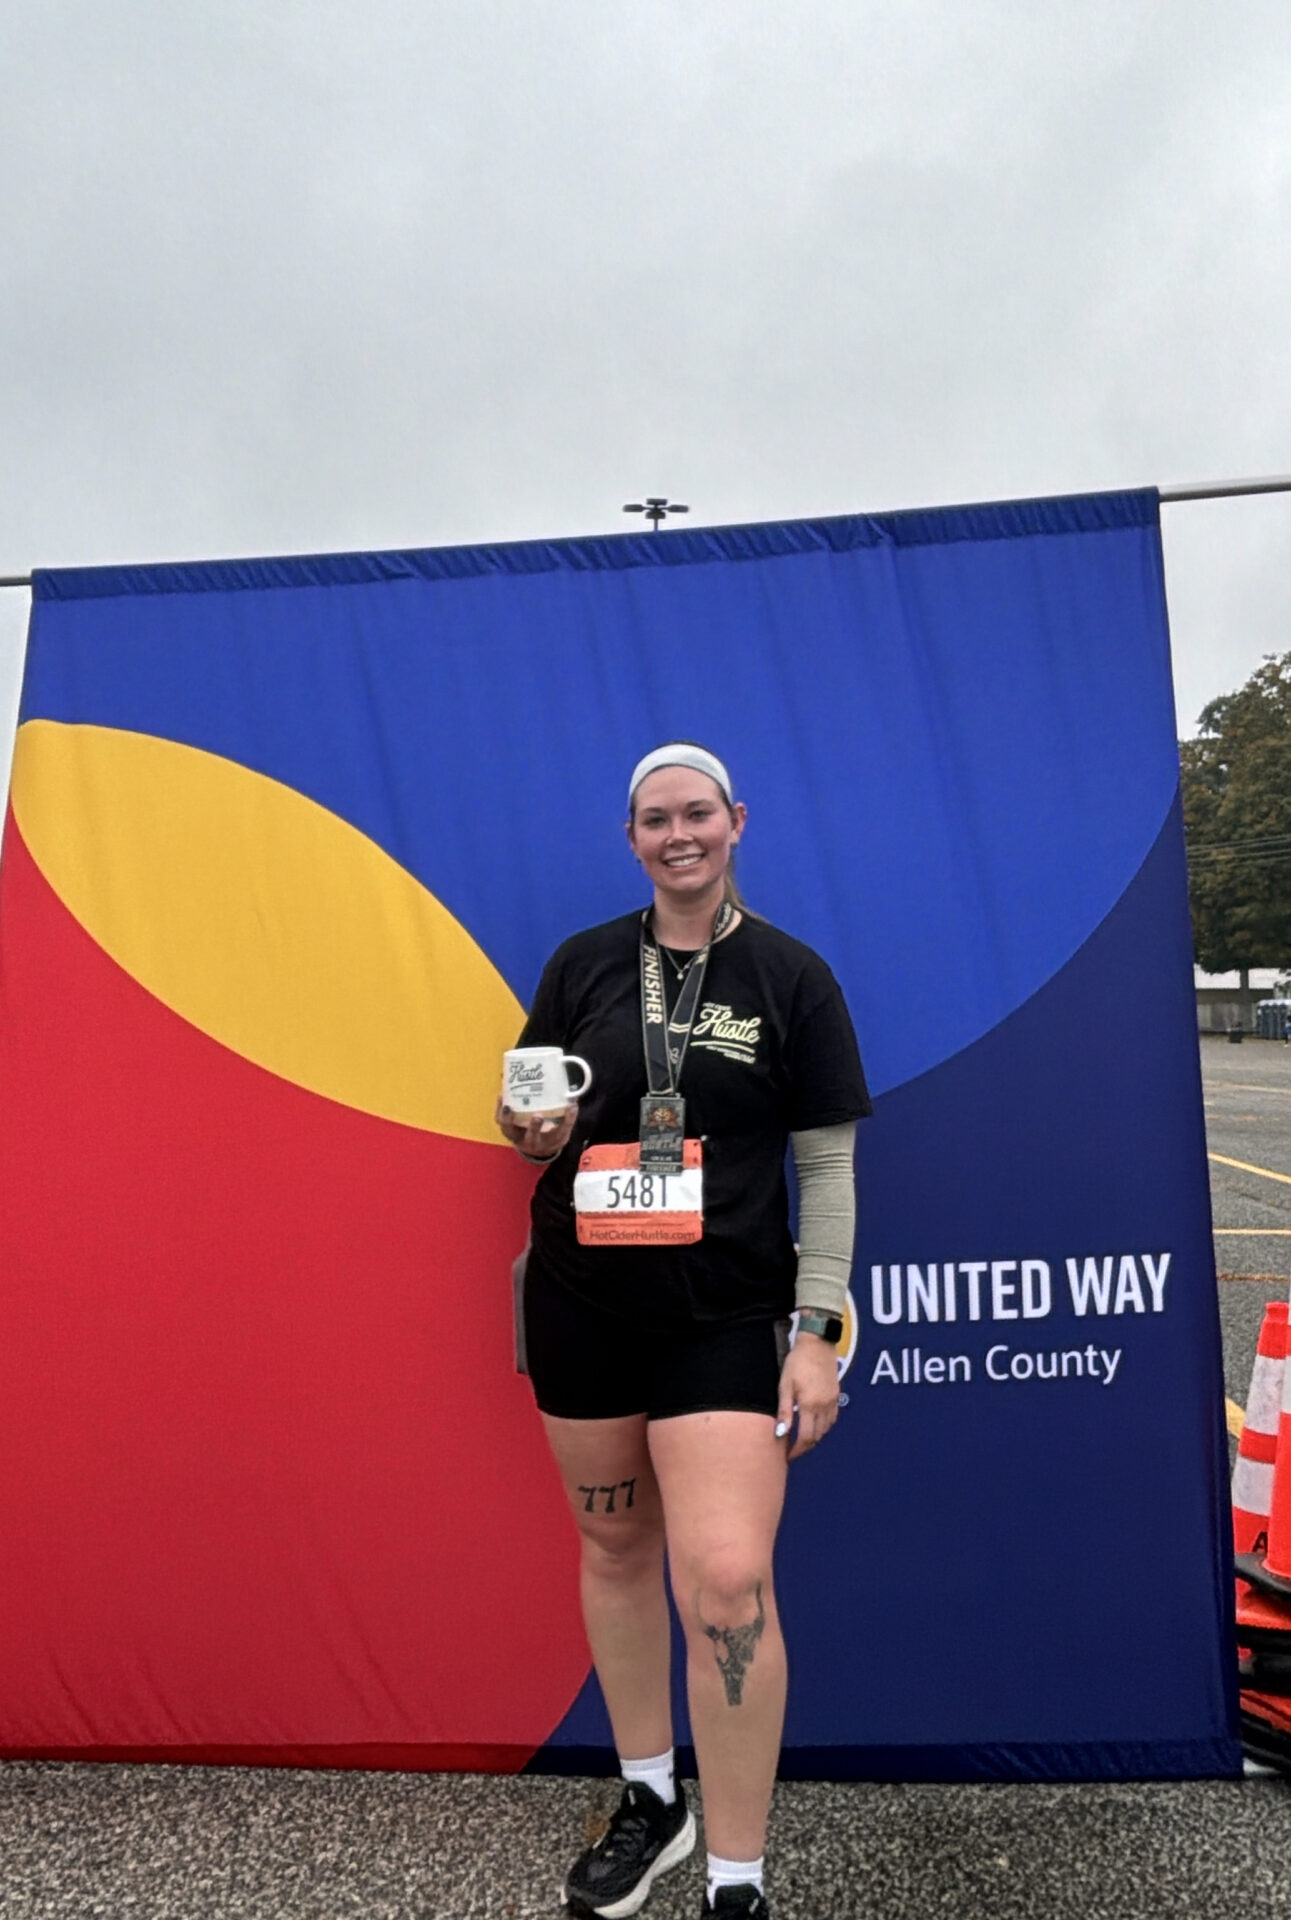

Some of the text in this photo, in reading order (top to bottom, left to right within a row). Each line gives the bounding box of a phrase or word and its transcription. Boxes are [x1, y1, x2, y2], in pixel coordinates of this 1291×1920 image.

[643, 944, 663, 1024] FINISHER
[692, 1007, 761, 1044] Hustle
[606, 1175, 667, 1209] 5481
[589, 1229, 697, 1240] HotCiderHustle.com
[870, 1253, 1171, 1324] UNITED WAY
[870, 1345, 1122, 1385] Allen County
[578, 1478, 636, 1513] 777
